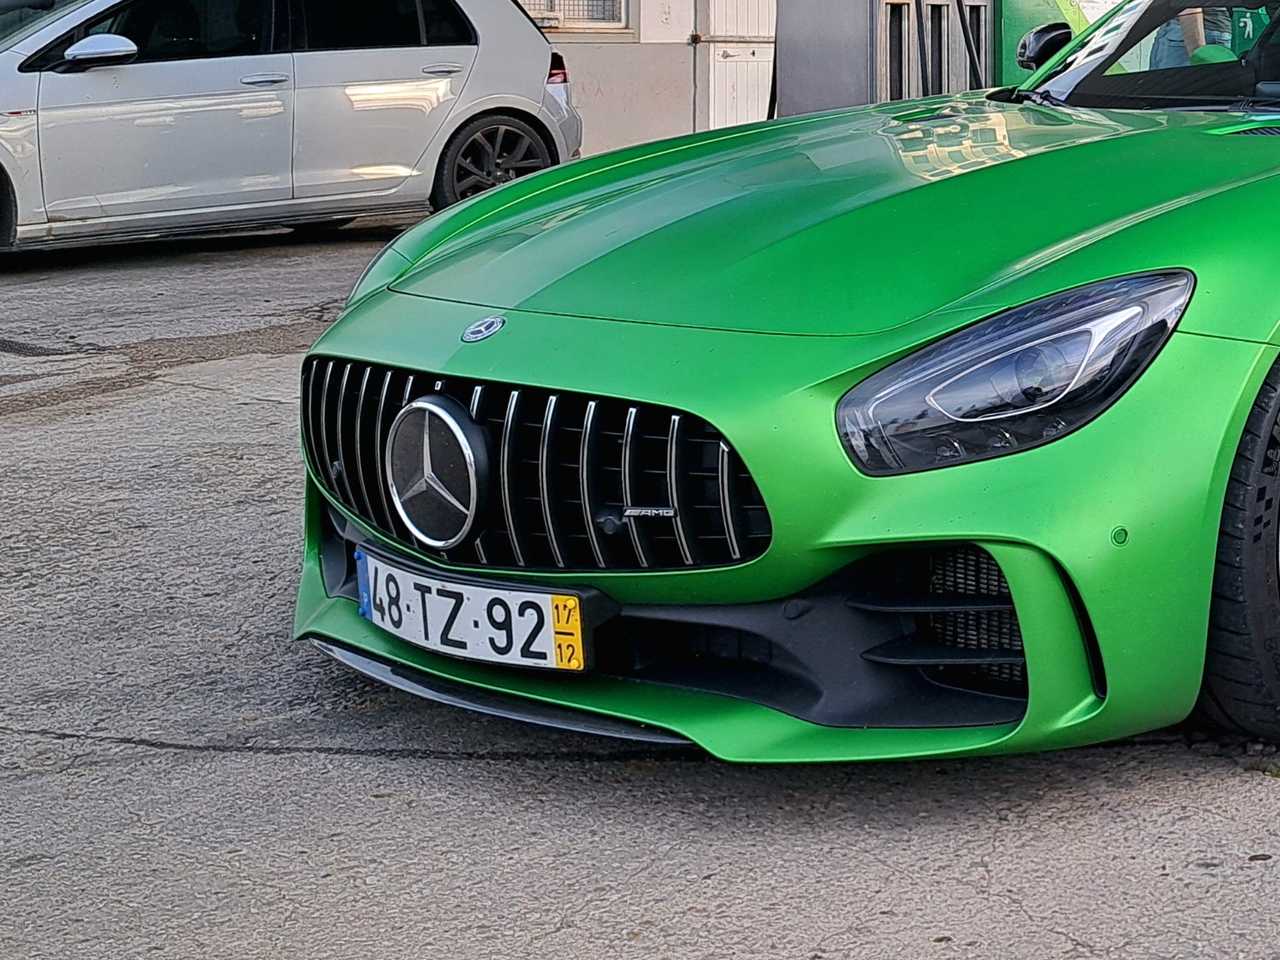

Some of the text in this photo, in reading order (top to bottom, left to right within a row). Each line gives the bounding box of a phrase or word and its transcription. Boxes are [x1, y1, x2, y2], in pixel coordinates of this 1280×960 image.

[639, 509, 675, 517] AMG
[362, 594, 369, 605] P
[554, 603, 574, 625] 17
[557, 643, 575, 664] 12
